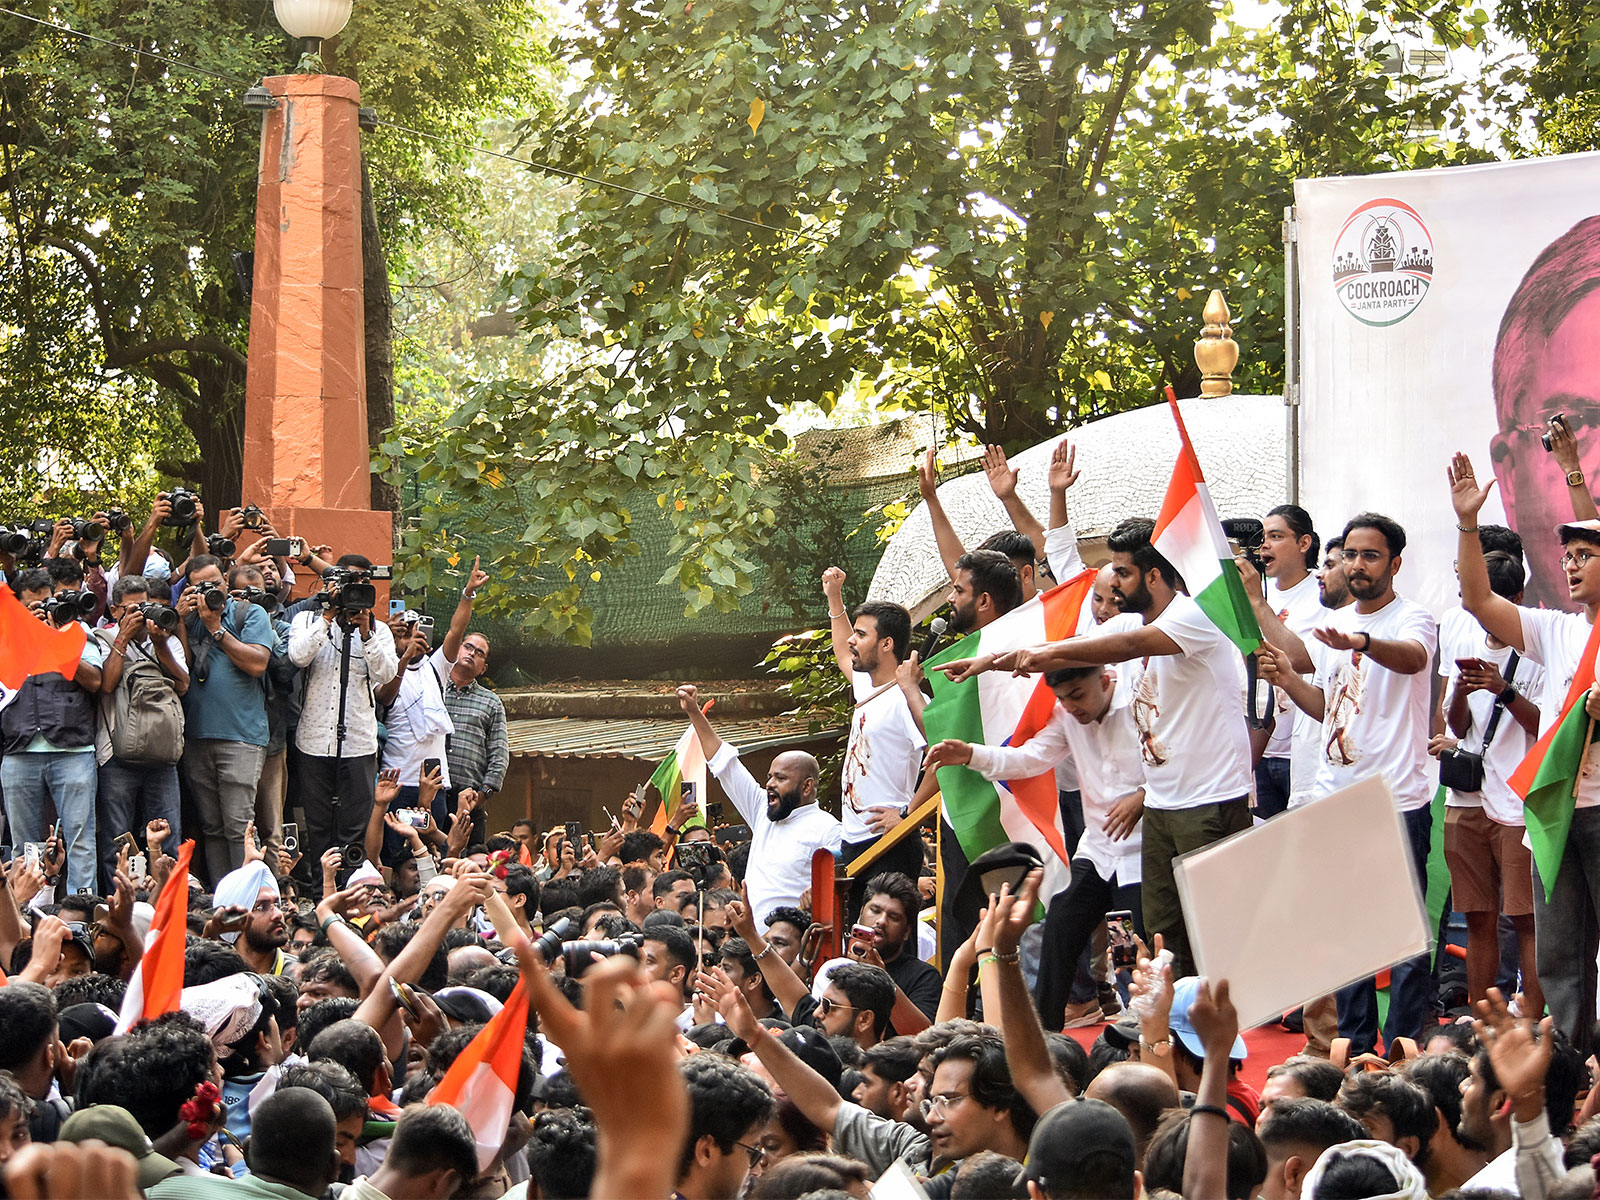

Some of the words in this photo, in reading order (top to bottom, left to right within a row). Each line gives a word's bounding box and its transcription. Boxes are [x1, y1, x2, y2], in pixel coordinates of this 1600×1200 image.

[1347, 279, 1420, 300] COCKROACH
[1357, 301, 1382, 310] JANTA
[1383, 299, 1408, 309] PARTY
